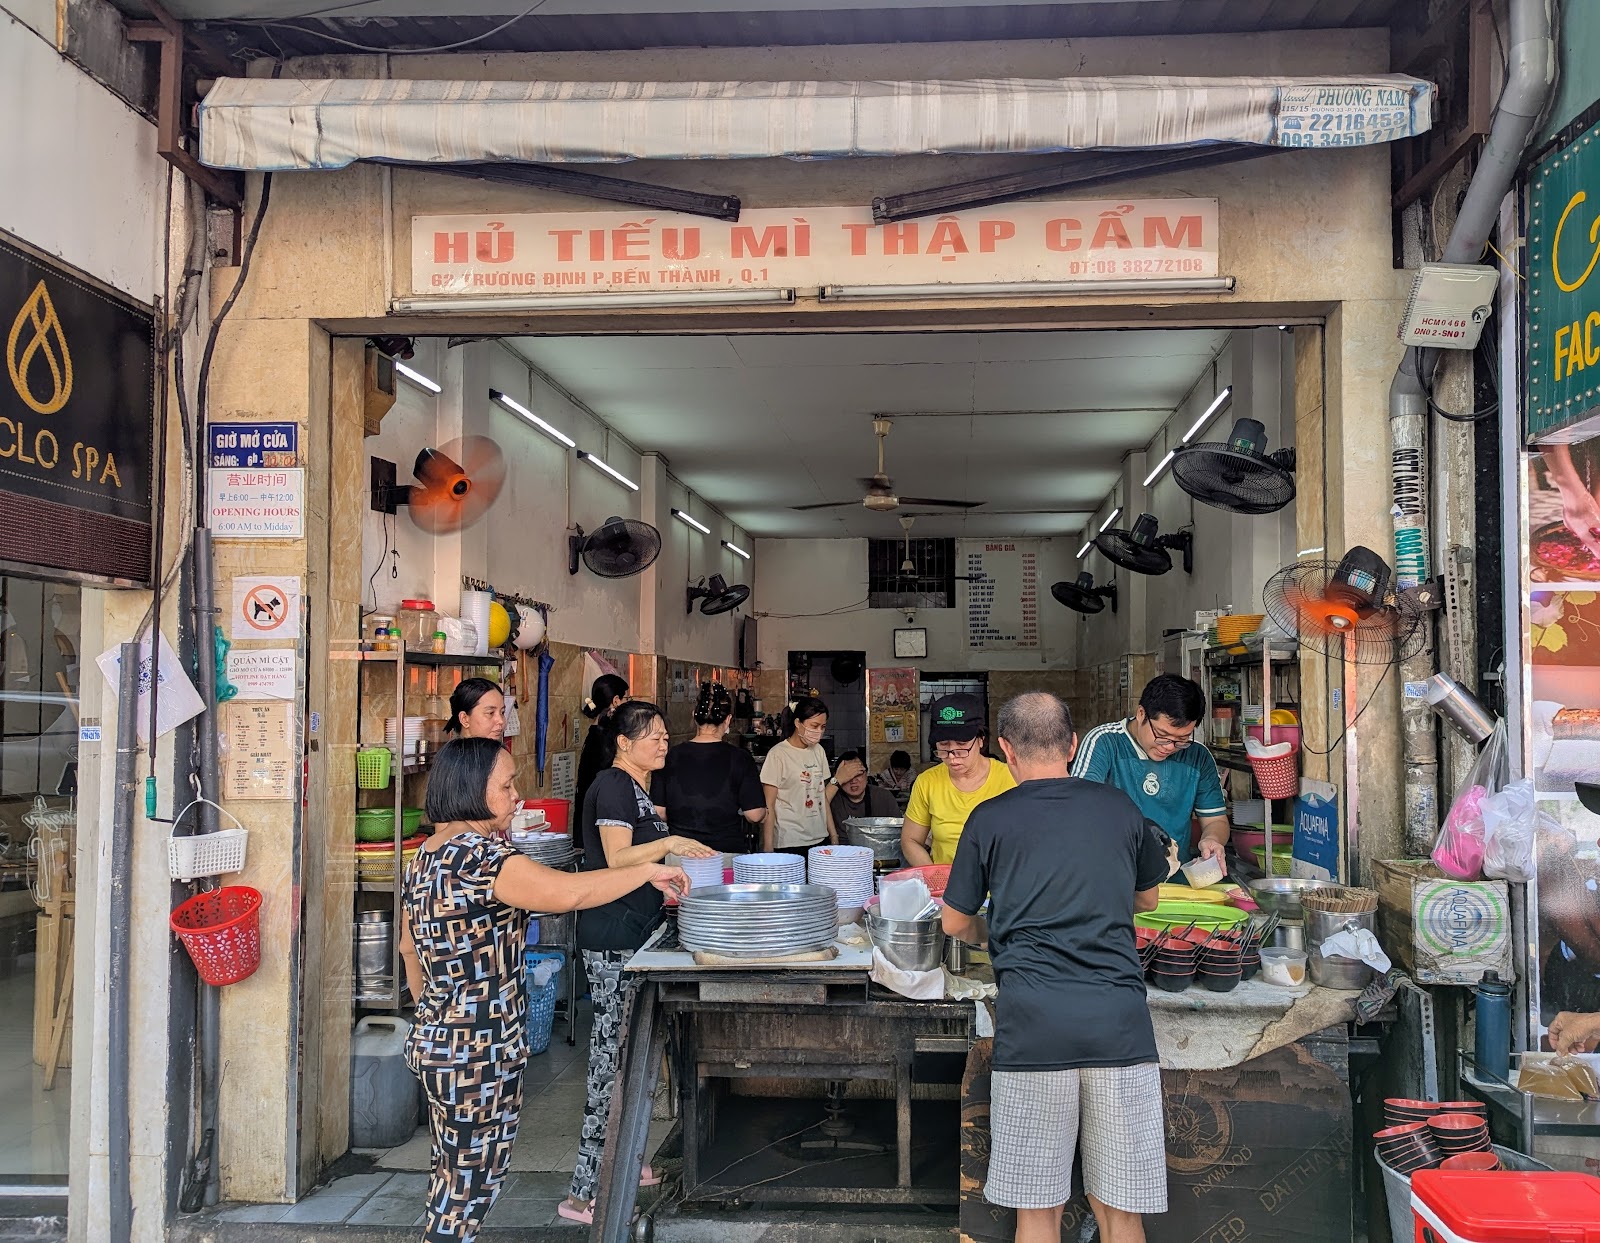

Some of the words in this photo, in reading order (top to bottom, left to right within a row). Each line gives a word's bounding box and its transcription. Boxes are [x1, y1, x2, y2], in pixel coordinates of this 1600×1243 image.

[1377, 88, 1405, 106] NAM
[434, 222, 514, 264] HỦ
[548, 218, 700, 262] TIẾU
[731, 218, 811, 259] MÌ
[842, 215, 1015, 262] THẬP
[1045, 204, 1202, 252] CẨM
[1069, 260, 1116, 275] ĐT:08
[1123, 258, 1203, 274] 38272108
[542, 268, 586, 288] ĐỊNH
[657, 264, 720, 284] THÀNH
[741, 267, 769, 283] Q.1
[216, 431, 238, 449] GIỜ
[240, 429, 260, 448] MỞ
[263, 429, 288, 448] CỬA
[72, 442, 122, 488] SPA
[214, 453, 240, 467] SÁNG:
[1393, 448, 1419, 473] 0977
[227, 473, 288, 487] 营业时间
[212, 508, 260, 517] OPENING
[263, 508, 300, 517] HOURS
[218, 523, 236, 531] 6:00
[237, 523, 252, 531] AM
[254, 523, 262, 531] to
[260, 656, 270, 664] MÌ
[892, 728, 899, 736] 31
[1450, 887, 1469, 949] AQUAFINA
[1192, 1147, 1253, 1198] PLYWOOD
